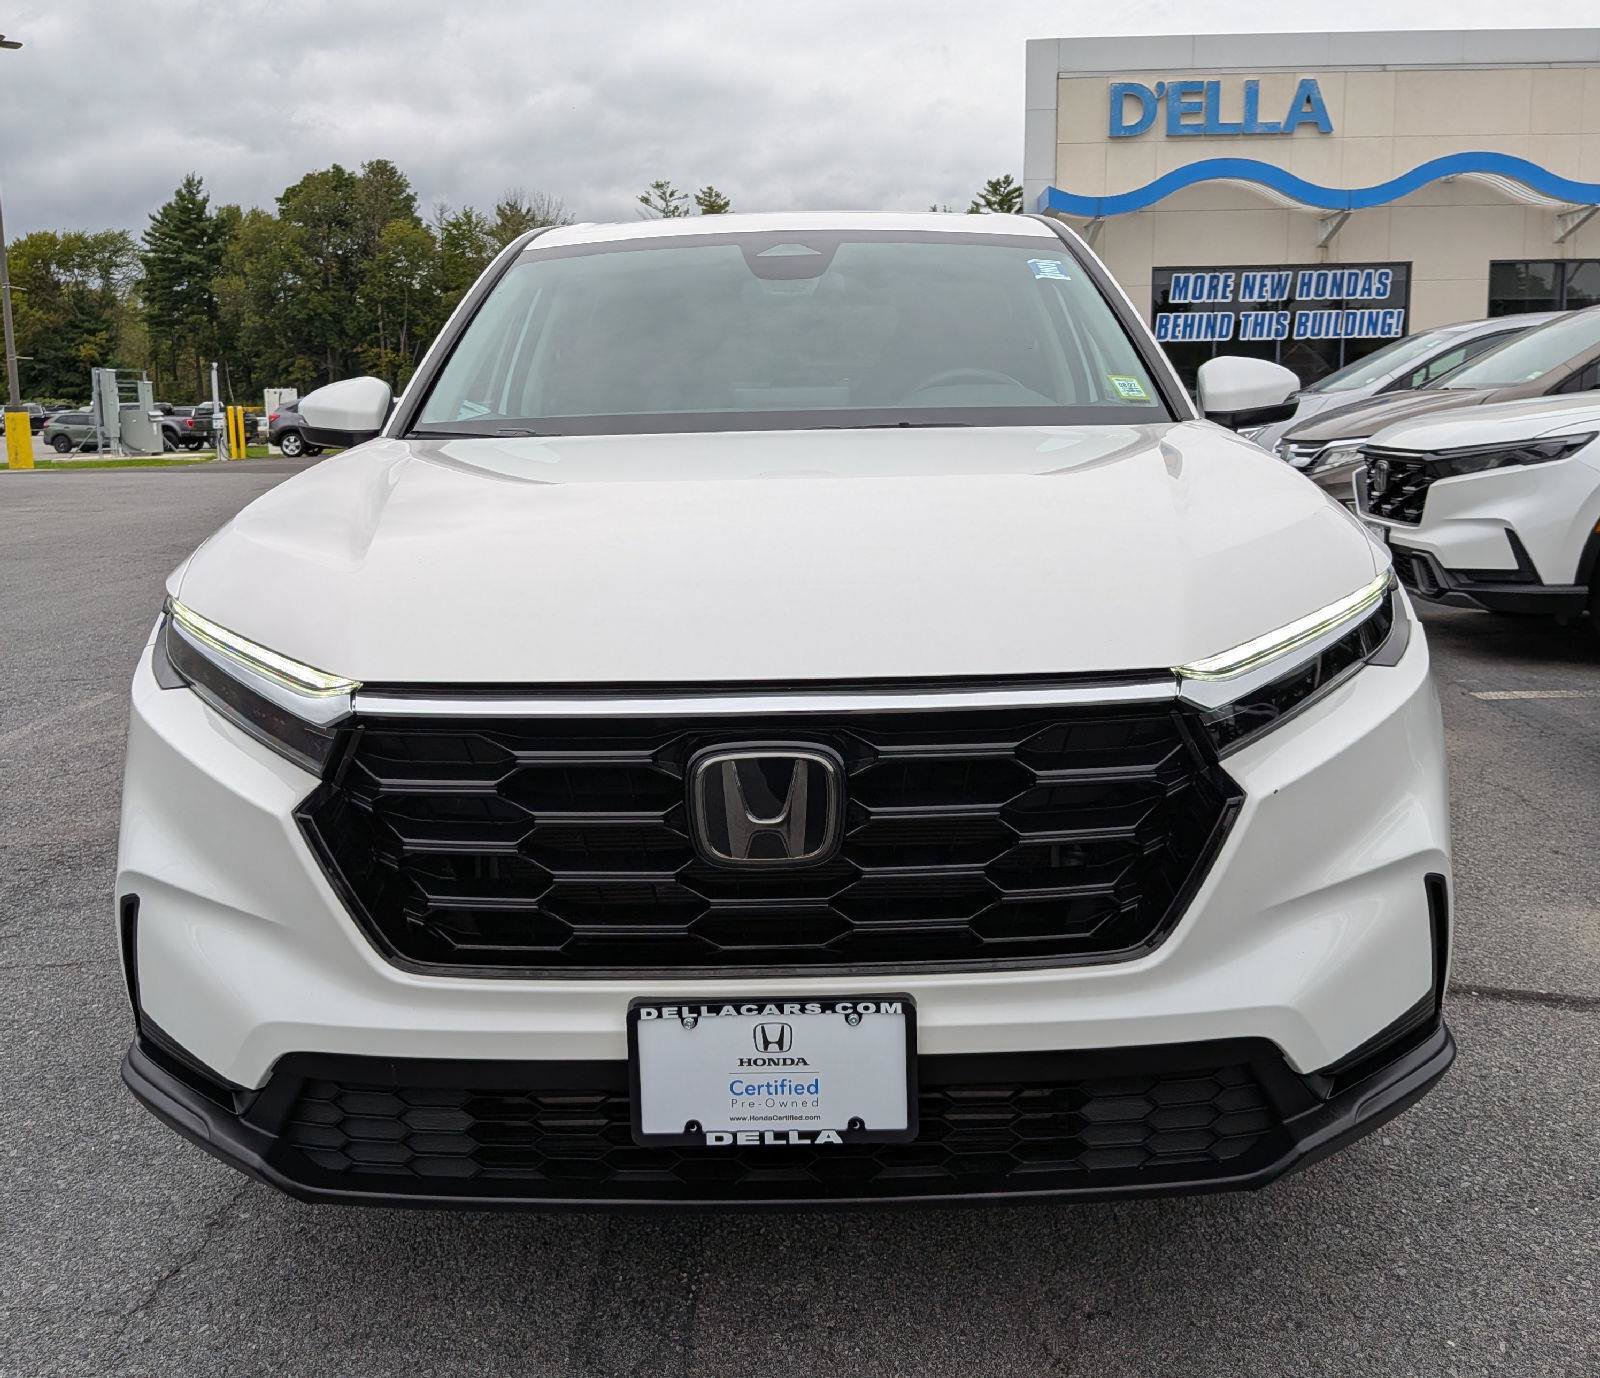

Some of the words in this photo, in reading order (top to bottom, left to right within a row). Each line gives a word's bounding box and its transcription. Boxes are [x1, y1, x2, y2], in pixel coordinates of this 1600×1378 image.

[1109, 78, 1334, 138] D'ELLA
[1169, 272, 1235, 303] MORE
[1239, 271, 1292, 302] NEW
[1296, 269, 1392, 300] HONDAS
[1155, 312, 1235, 342] BEHIND
[1239, 311, 1290, 340] THIS
[1293, 309, 1404, 339] BUILDING!
[640, 1002, 902, 1020] DELLACARS.COM
[737, 1057, 810, 1067] HONDA
[729, 1078, 819, 1096] Certified
[731, 1097, 819, 1108] Pre-Owned
[706, 1129, 843, 1146] DELLA
